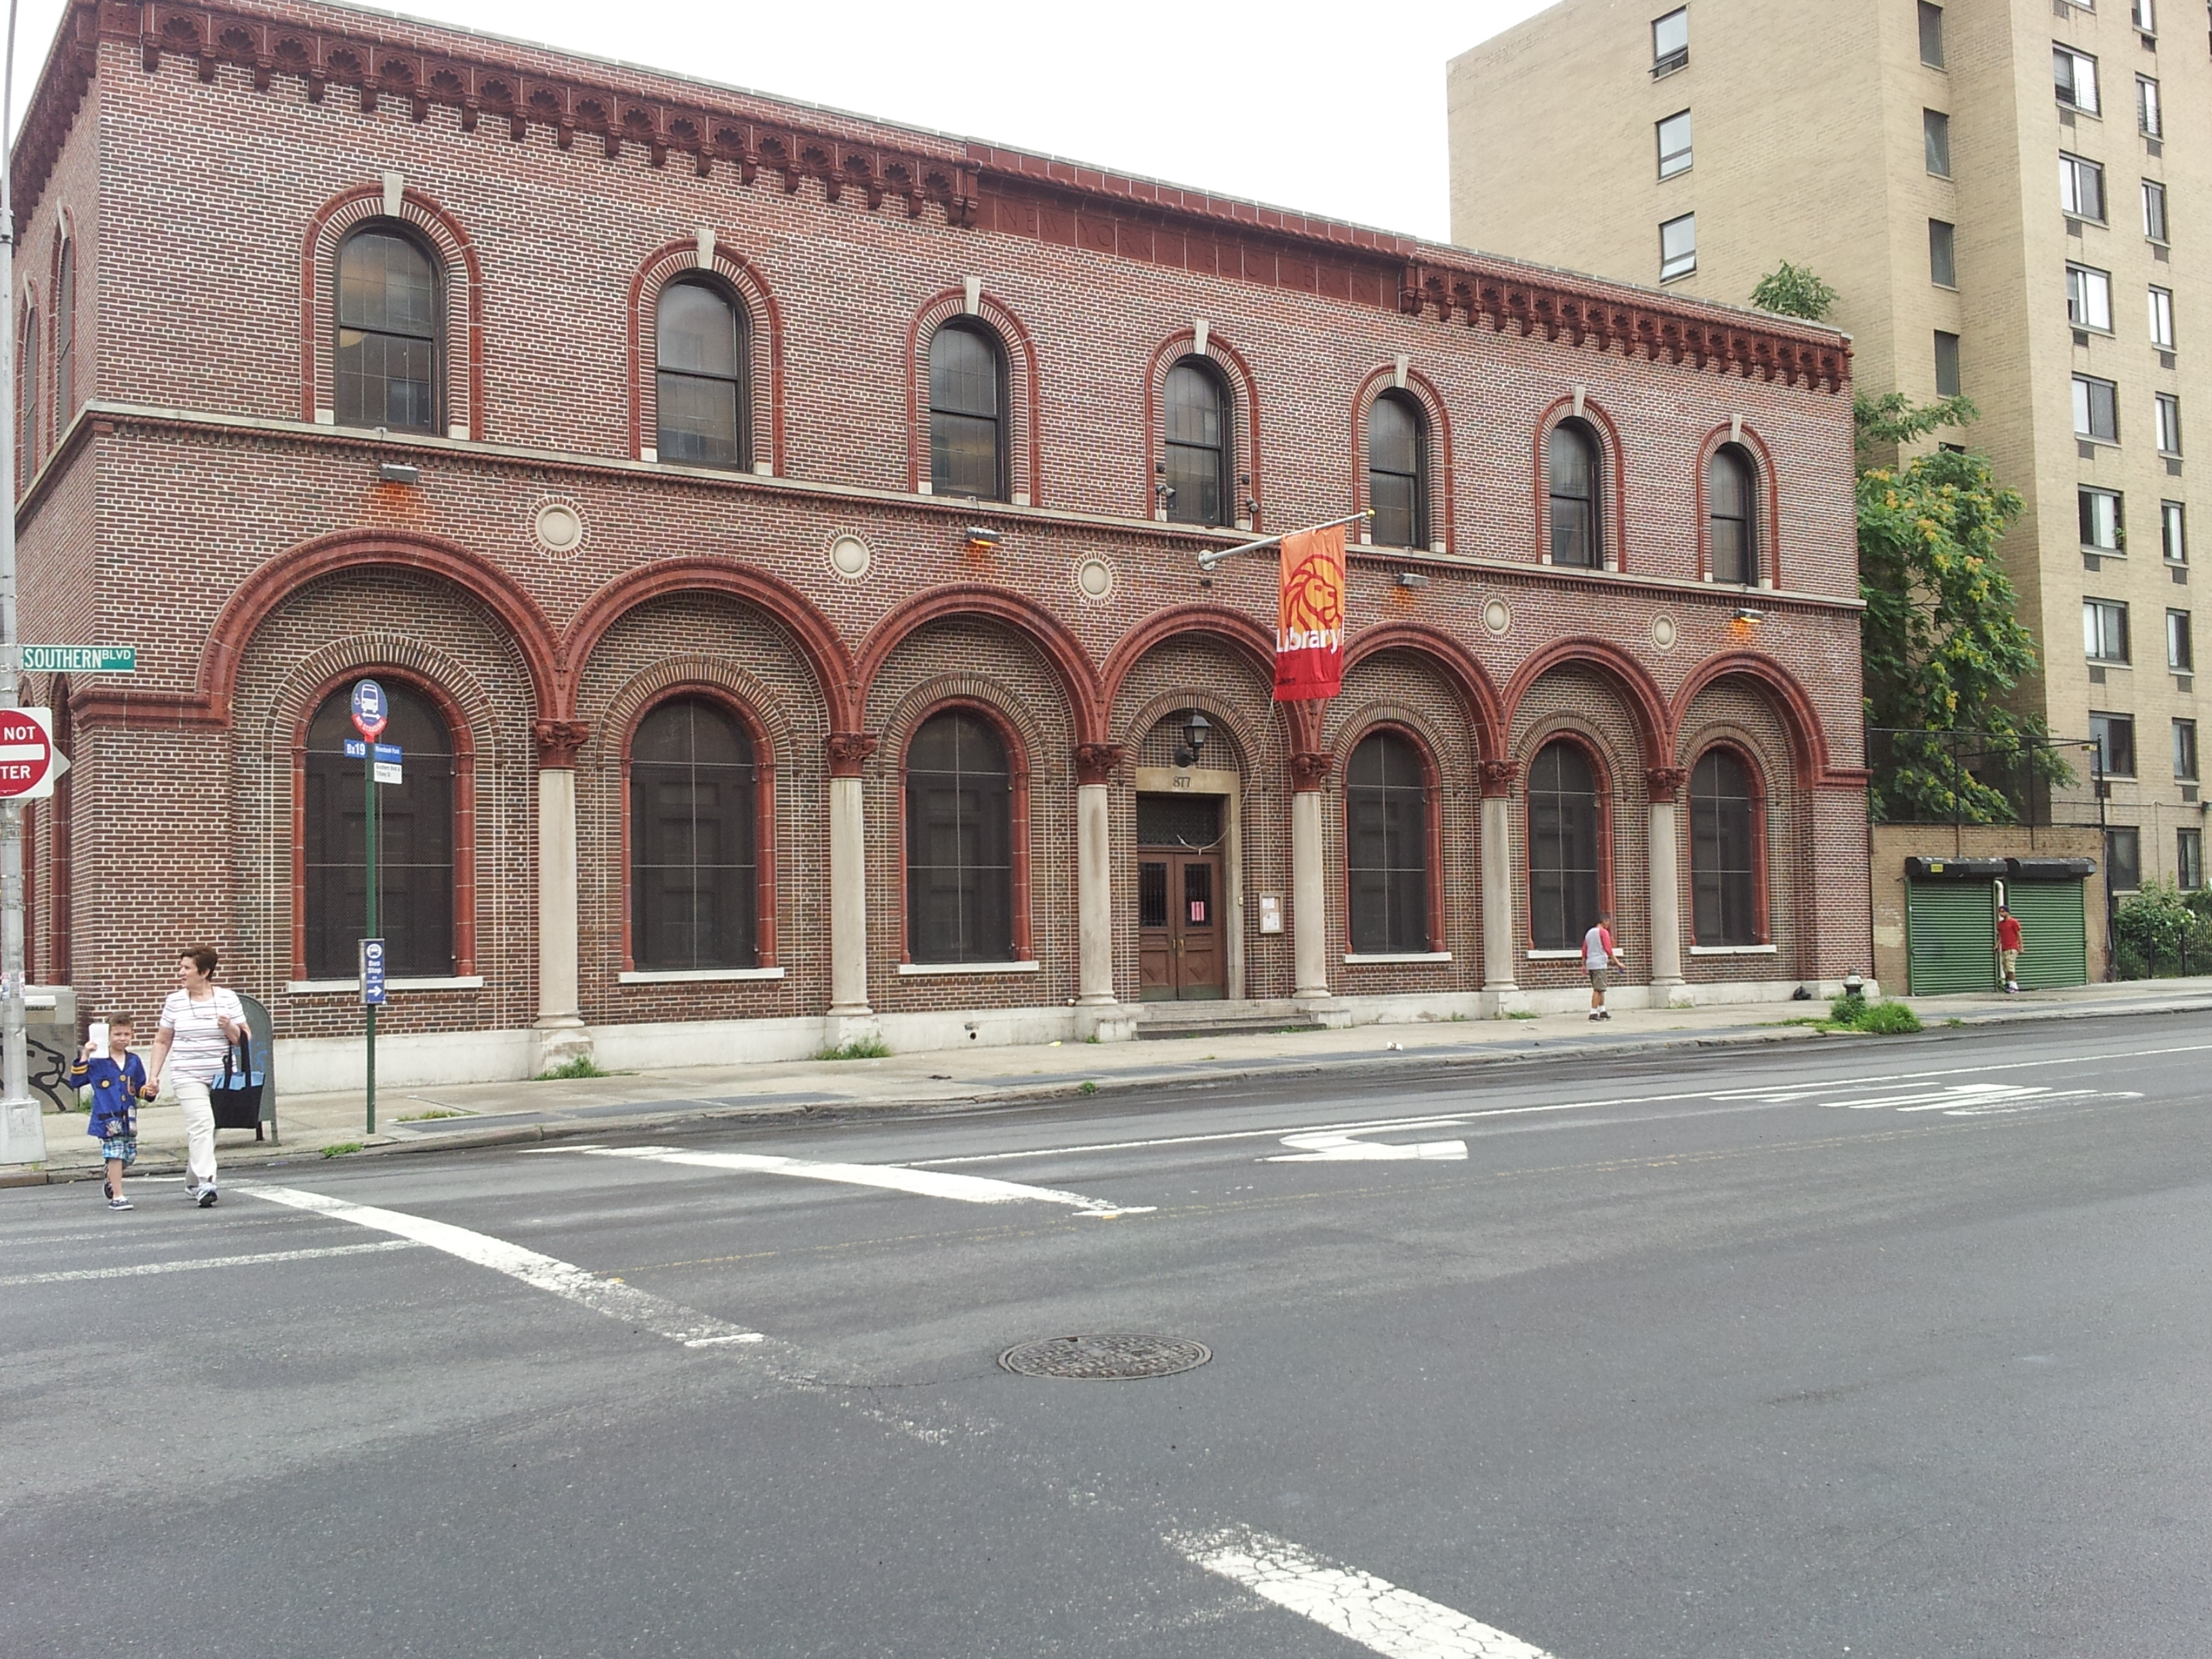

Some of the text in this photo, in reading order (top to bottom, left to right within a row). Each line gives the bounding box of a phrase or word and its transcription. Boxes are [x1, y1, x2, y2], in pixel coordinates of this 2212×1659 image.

[1001, 201, 1060, 234] NEW
[1077, 217, 1153, 255] YORK
[1281, 256, 1380, 298] LIBRARY
[1276, 626, 1341, 655] Library
[24, 648, 131, 668] SOUTHERN BLVD
[3, 726, 36, 741] NOT
[347, 743, 365, 756] Bx19
[1173, 776, 1191, 788] 877
